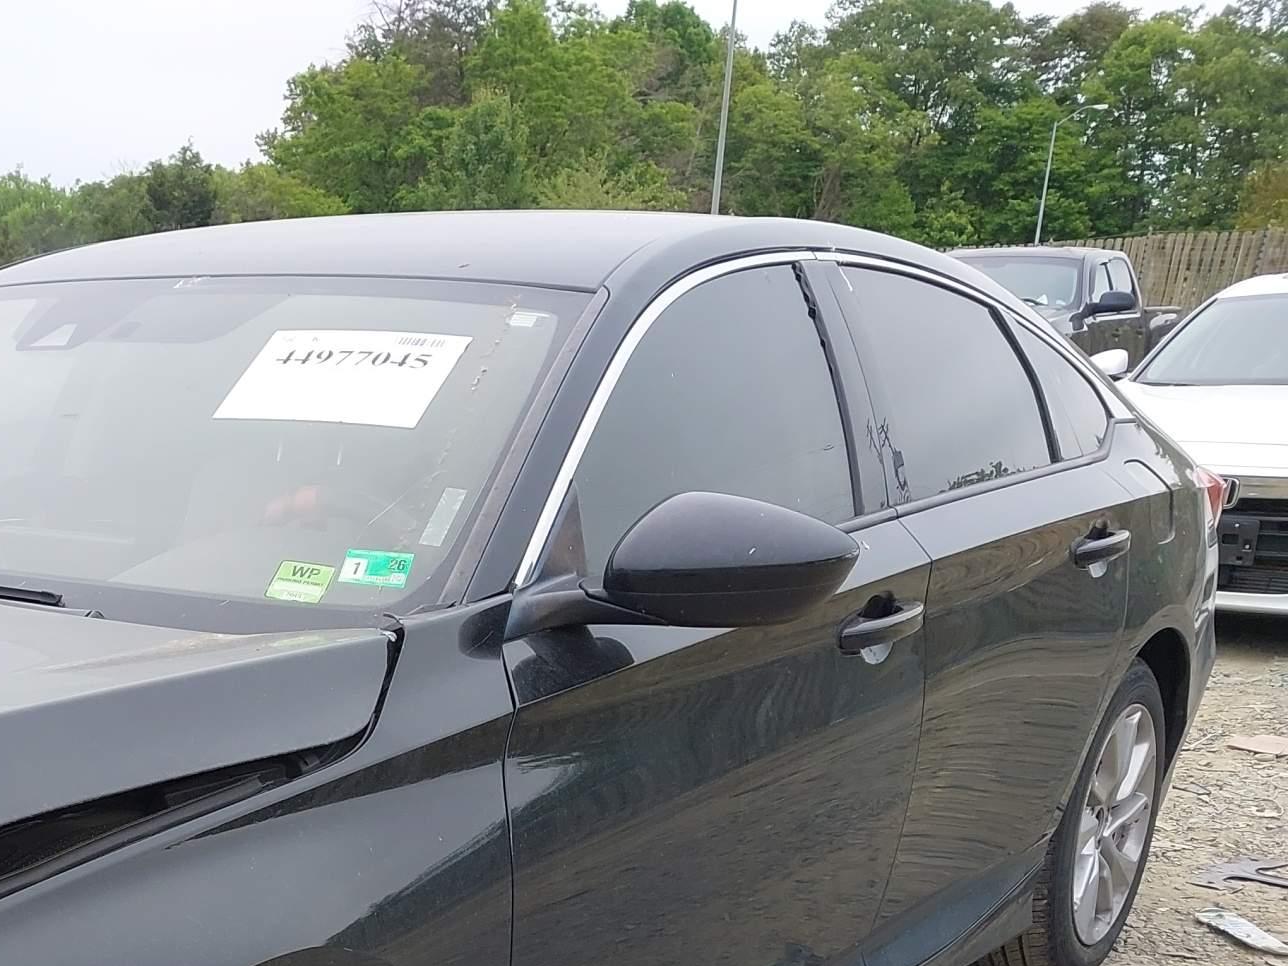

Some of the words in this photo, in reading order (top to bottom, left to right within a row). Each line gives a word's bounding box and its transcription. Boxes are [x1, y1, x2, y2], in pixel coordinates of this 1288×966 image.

[275, 349, 433, 369] 44977045
[291, 565, 321, 579] WP
[352, 561, 361, 575] 1
[388, 558, 407, 571] 26
